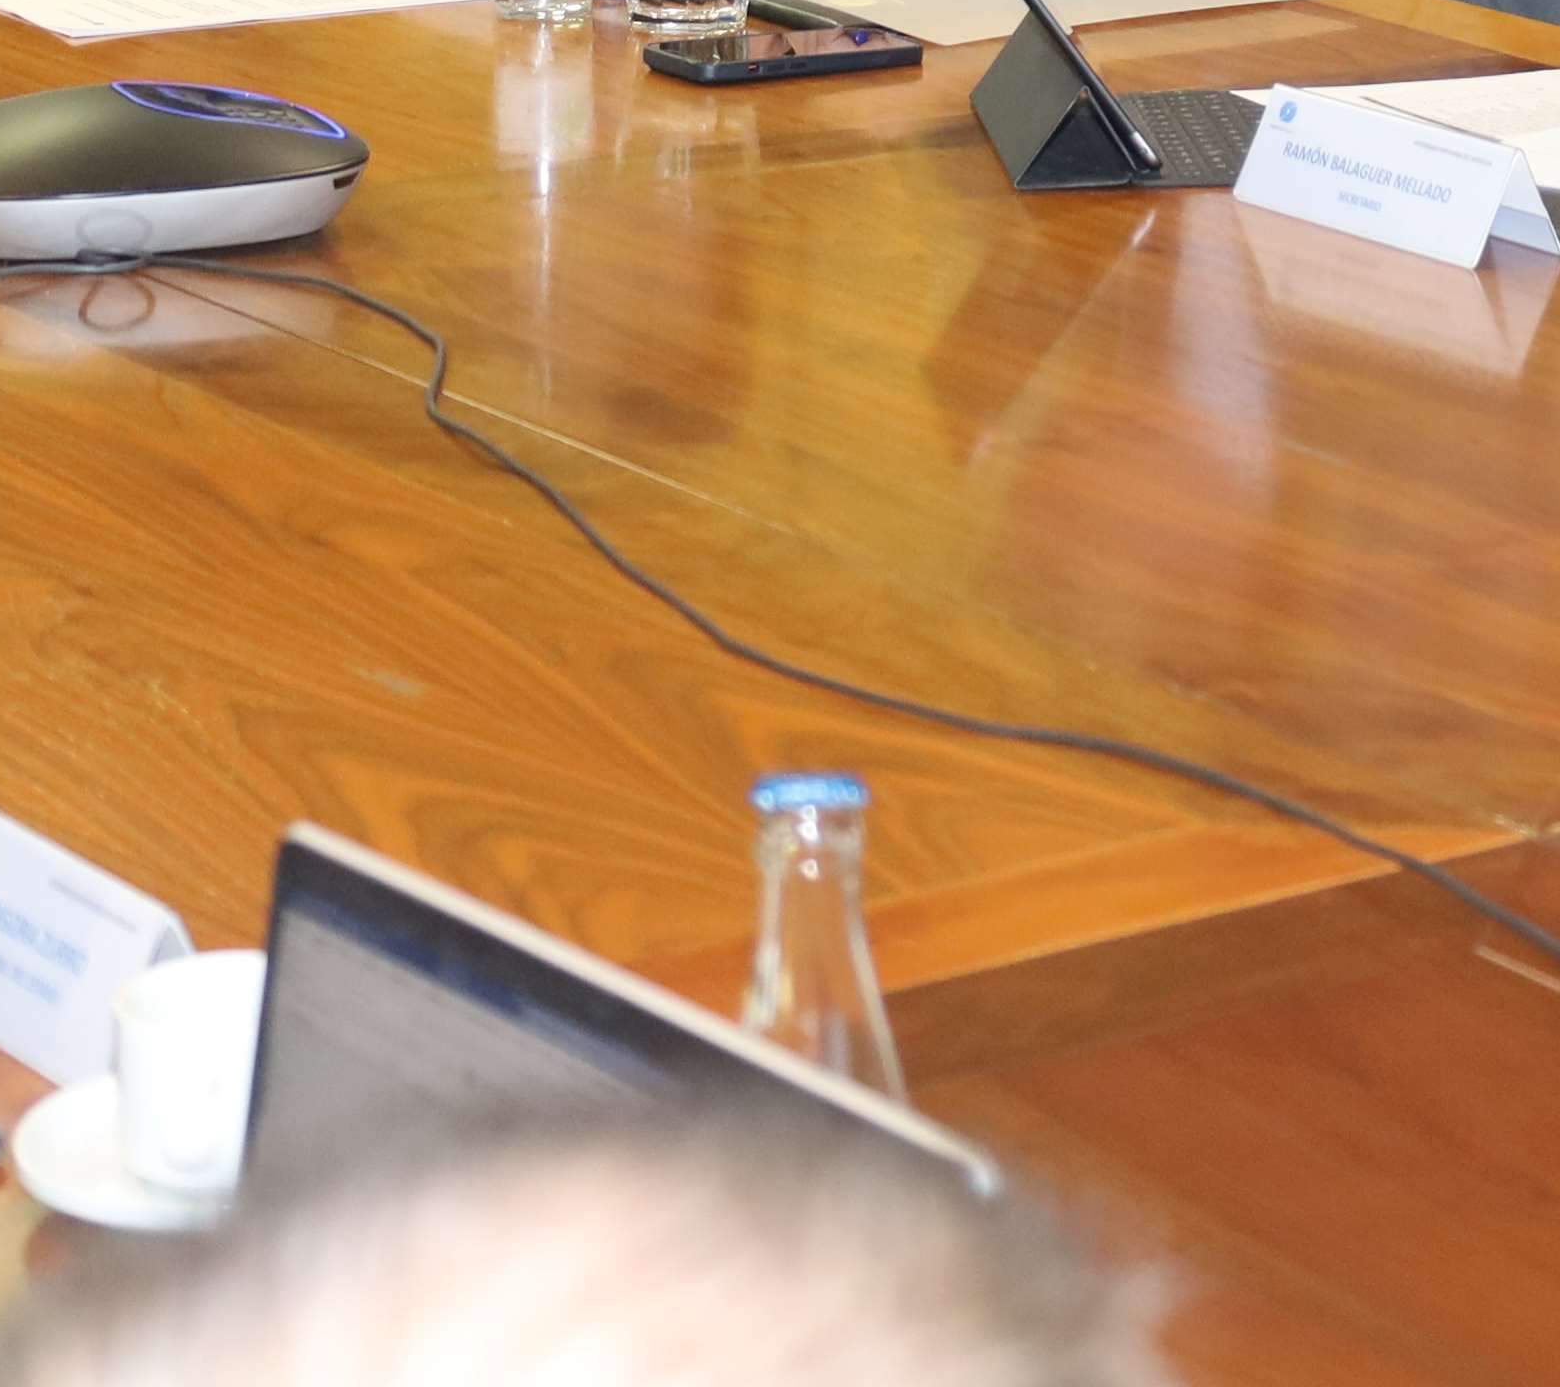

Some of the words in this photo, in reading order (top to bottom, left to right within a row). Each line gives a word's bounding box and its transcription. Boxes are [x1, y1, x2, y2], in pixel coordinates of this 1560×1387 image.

[1283, 140, 1327, 168] RAMÓN
[1329, 154, 1393, 186] BALAGUER
[1392, 171, 1452, 204] MELLADO
